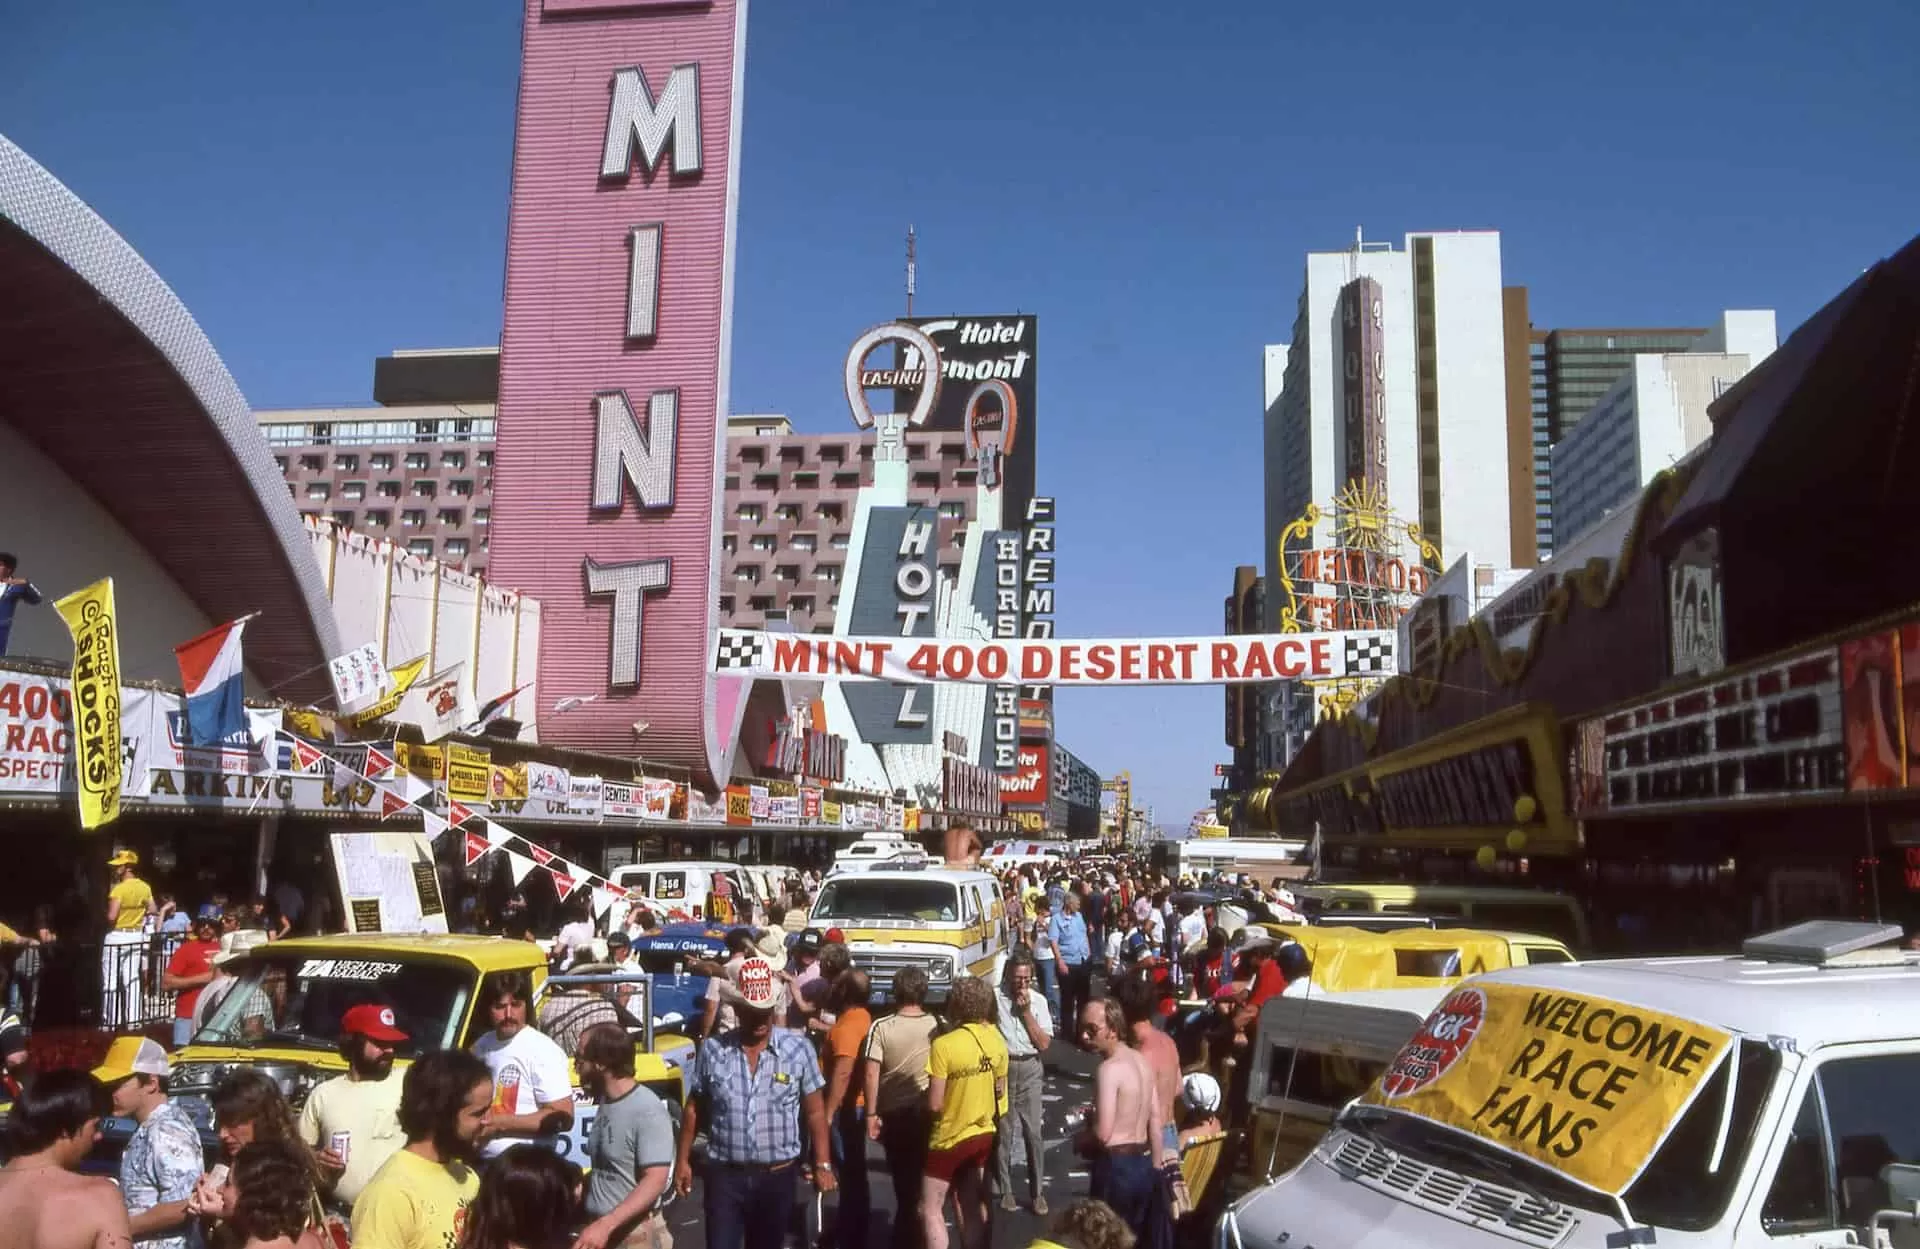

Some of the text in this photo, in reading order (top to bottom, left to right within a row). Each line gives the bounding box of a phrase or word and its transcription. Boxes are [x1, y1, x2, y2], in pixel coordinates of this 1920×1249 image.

[903, 321, 1031, 380] Femont
[959, 320, 1025, 345] Hotel
[585, 61, 703, 688] MINT
[861, 369, 925, 386] CASINO
[1025, 497, 1052, 702] FREMOT
[896, 519, 934, 726] HOTL
[95, 624, 113, 688] Rough
[774, 637, 1332, 681] MINT 400 DESERT RACE
[995, 537, 1020, 770] HORSHOE
[0, 682, 74, 723] 400
[78, 633, 108, 784] SHOCKS
[5, 724, 74, 755] RAC
[151, 769, 293, 800] ARKING
[604, 786, 631, 803] CENTER
[333, 959, 370, 970] HIGH
[367, 961, 403, 974] TECH
[650, 940, 674, 950] Hanna
[329, 968, 382, 980] RADIALS
[741, 967, 769, 980] NGK
[1523, 991, 1712, 1077] WELCOME
[1508, 1037, 1639, 1112] RACE
[1471, 1085, 1598, 1159] FANS
